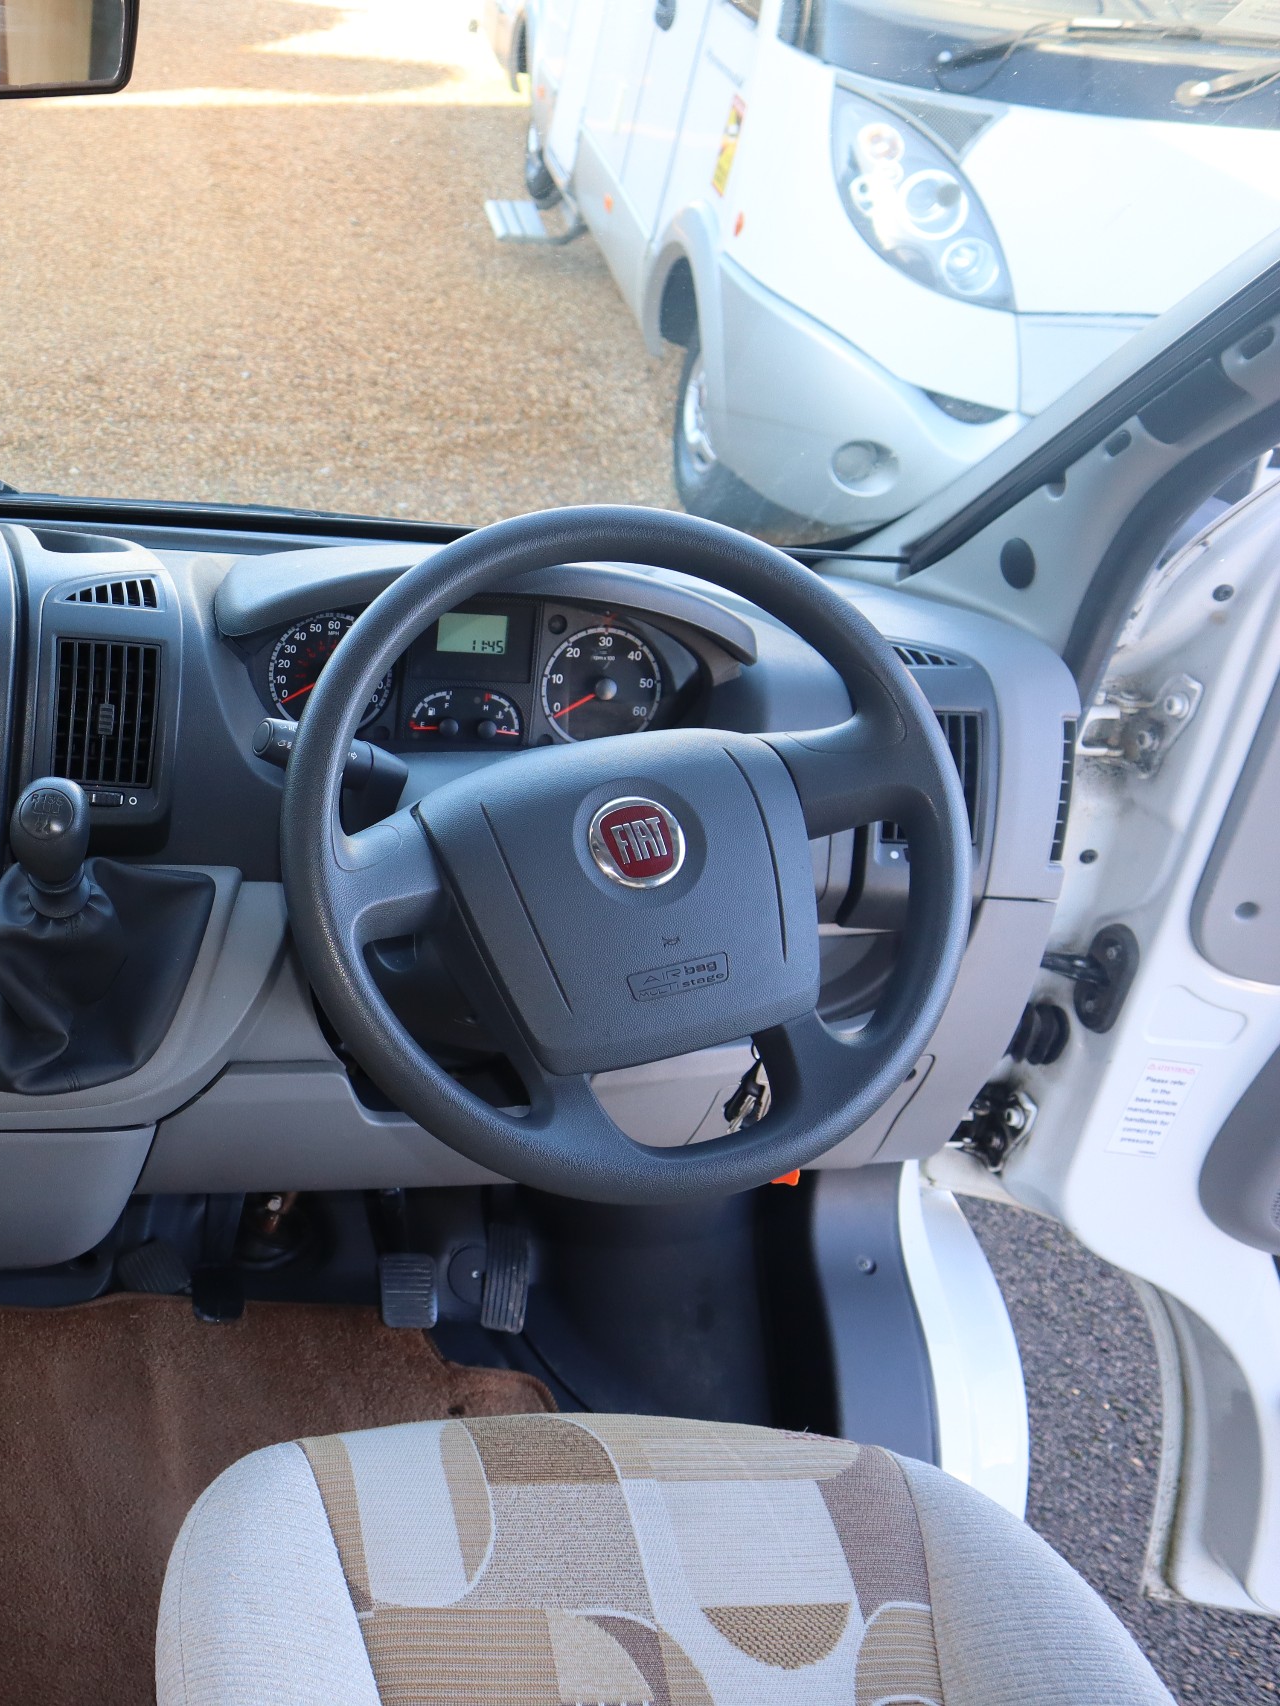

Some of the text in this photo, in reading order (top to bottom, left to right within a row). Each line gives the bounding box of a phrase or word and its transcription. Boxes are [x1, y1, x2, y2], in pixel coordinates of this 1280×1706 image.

[309, 623, 322, 633] 50
[328, 621, 341, 630] 60
[294, 632, 306, 641] 40
[598, 636, 613, 647] 30
[284, 644, 297, 654] 30
[566, 647, 581, 658] 20
[627, 650, 642, 661] 40
[277, 659, 290, 668] 20
[276, 675, 286, 684] 10
[551, 673, 564, 684] 10
[639, 678, 653, 689] 50
[281, 689, 288, 698] 0
[553, 702, 561, 712] 0
[632, 706, 647, 716] 60
[610, 816, 668, 865] FIAT
